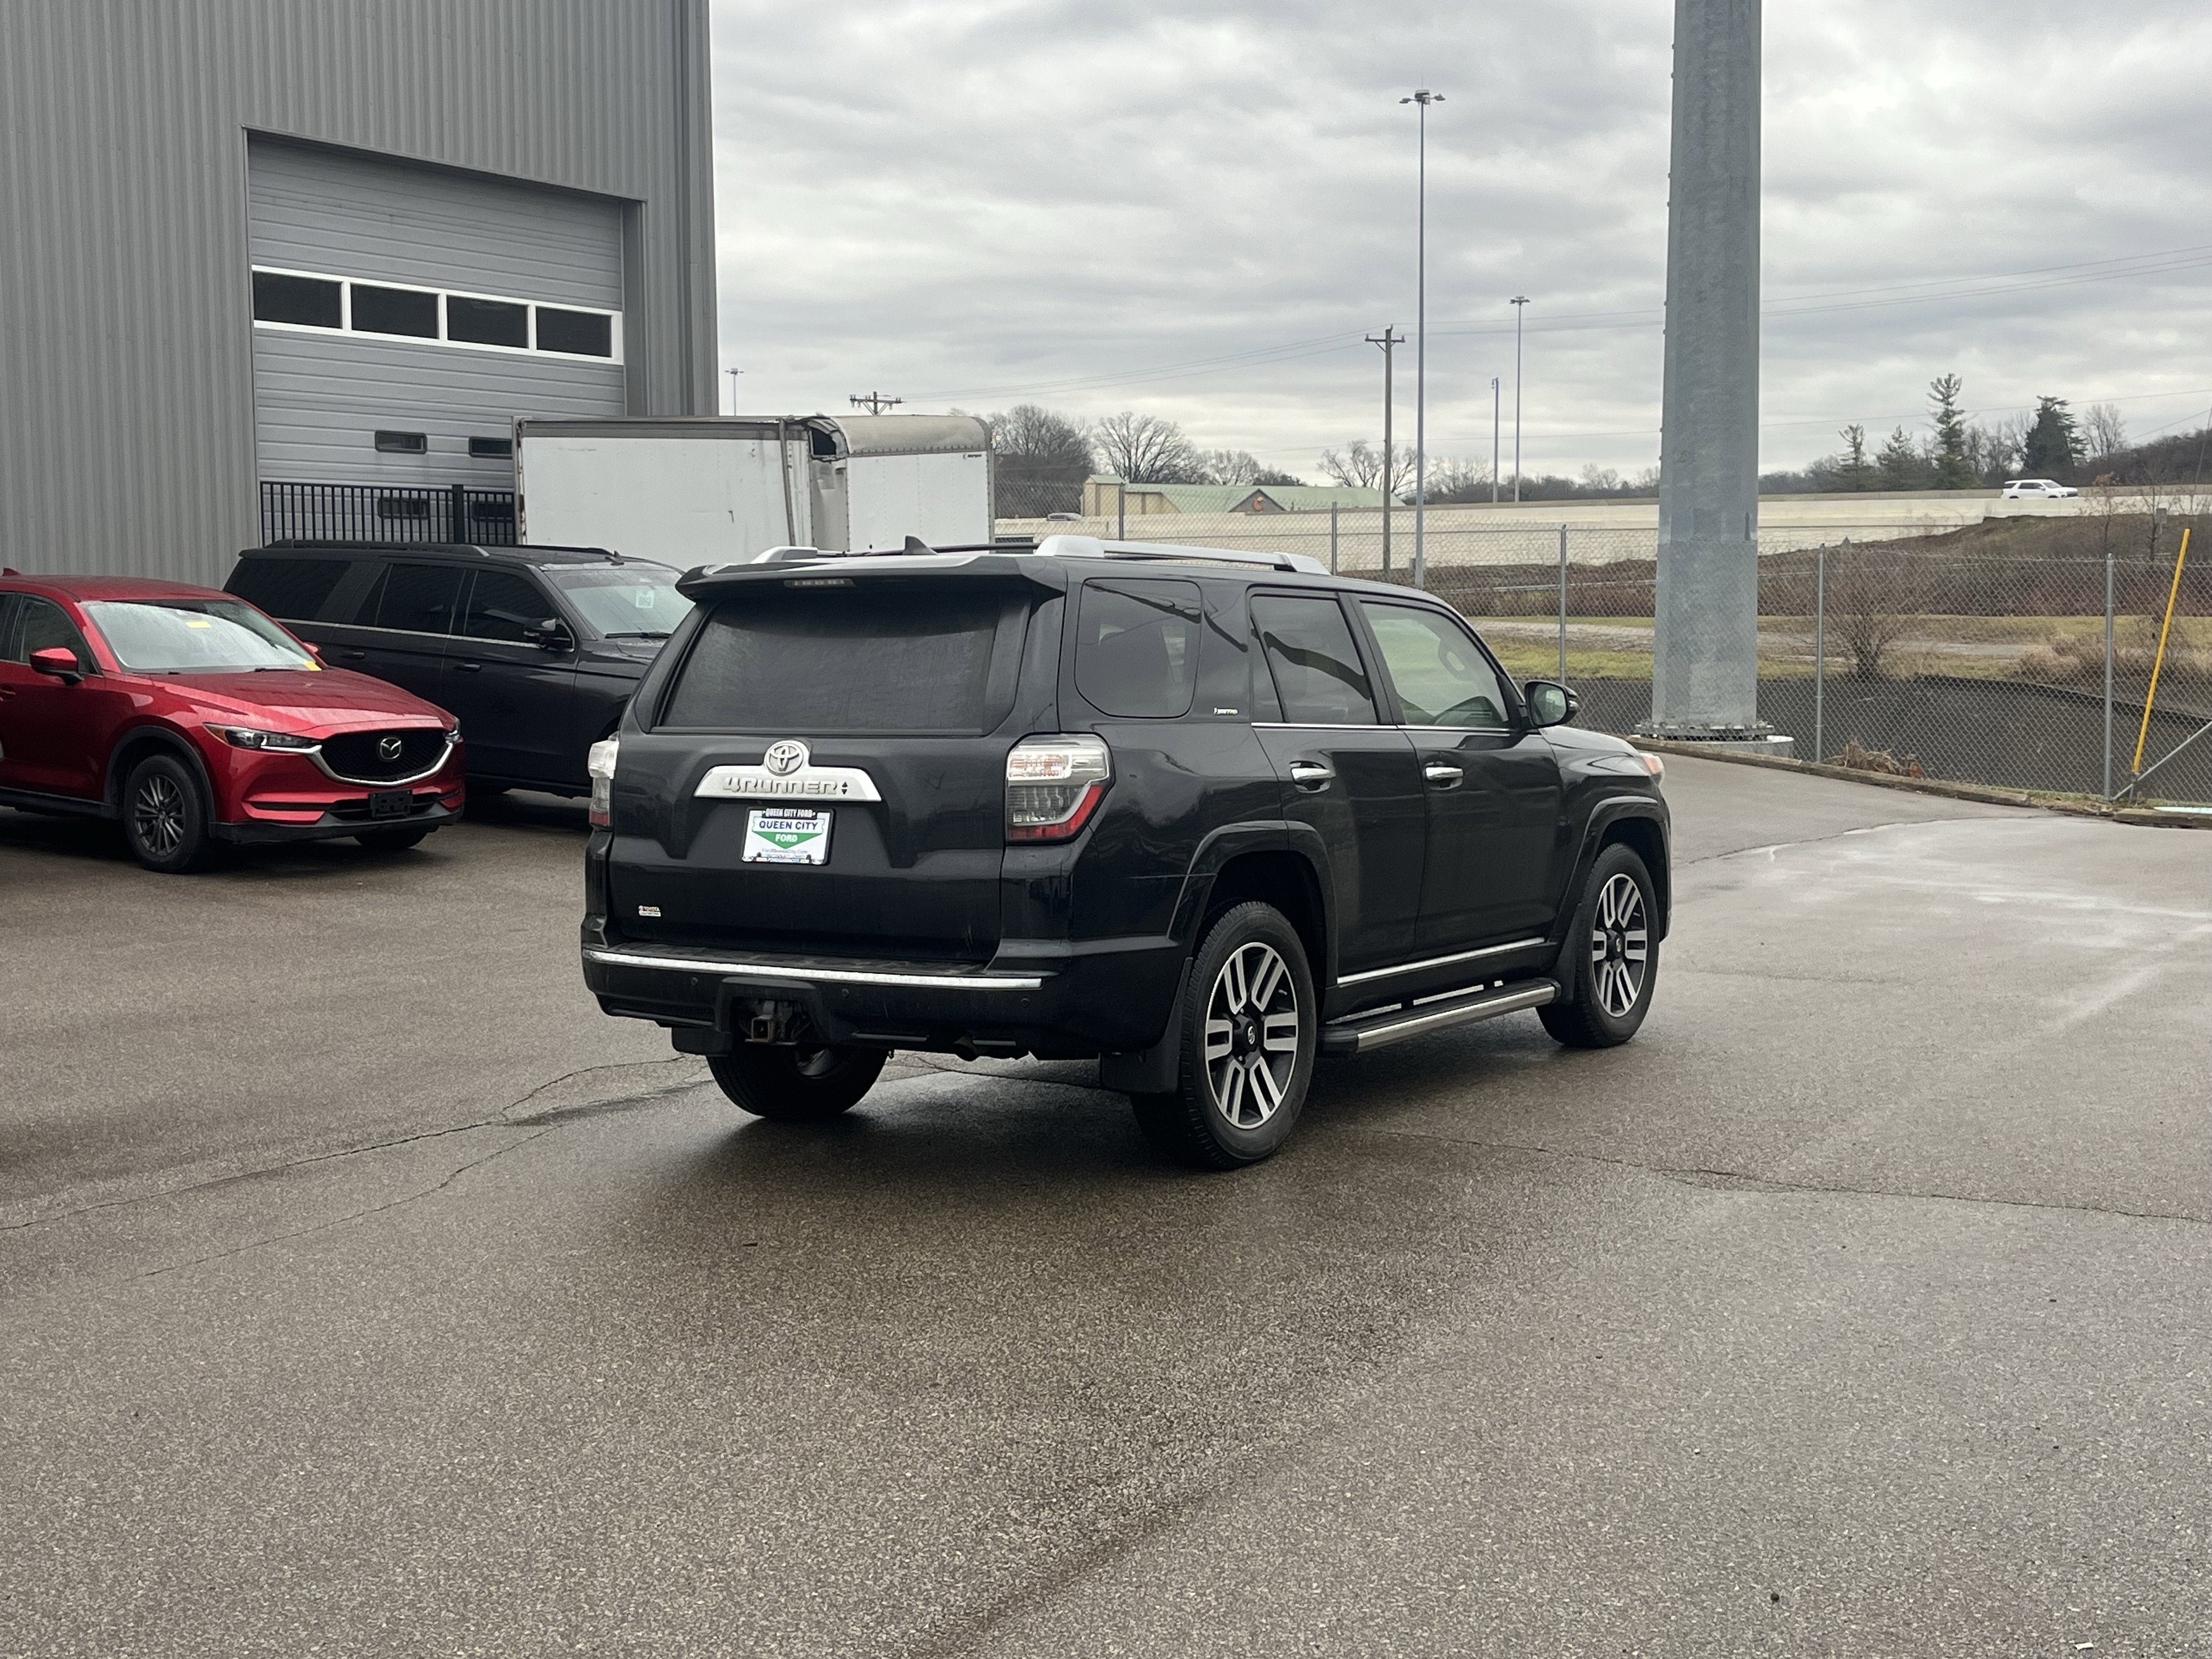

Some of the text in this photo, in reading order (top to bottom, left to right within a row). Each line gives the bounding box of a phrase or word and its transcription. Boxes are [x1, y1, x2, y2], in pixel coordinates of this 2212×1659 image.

[724, 777, 837, 794] 4RUNNER
[765, 808, 812, 817] QUEEN CITY FORD
[759, 821, 818, 830] QUEEN CITY
[775, 834, 798, 842] FORD
